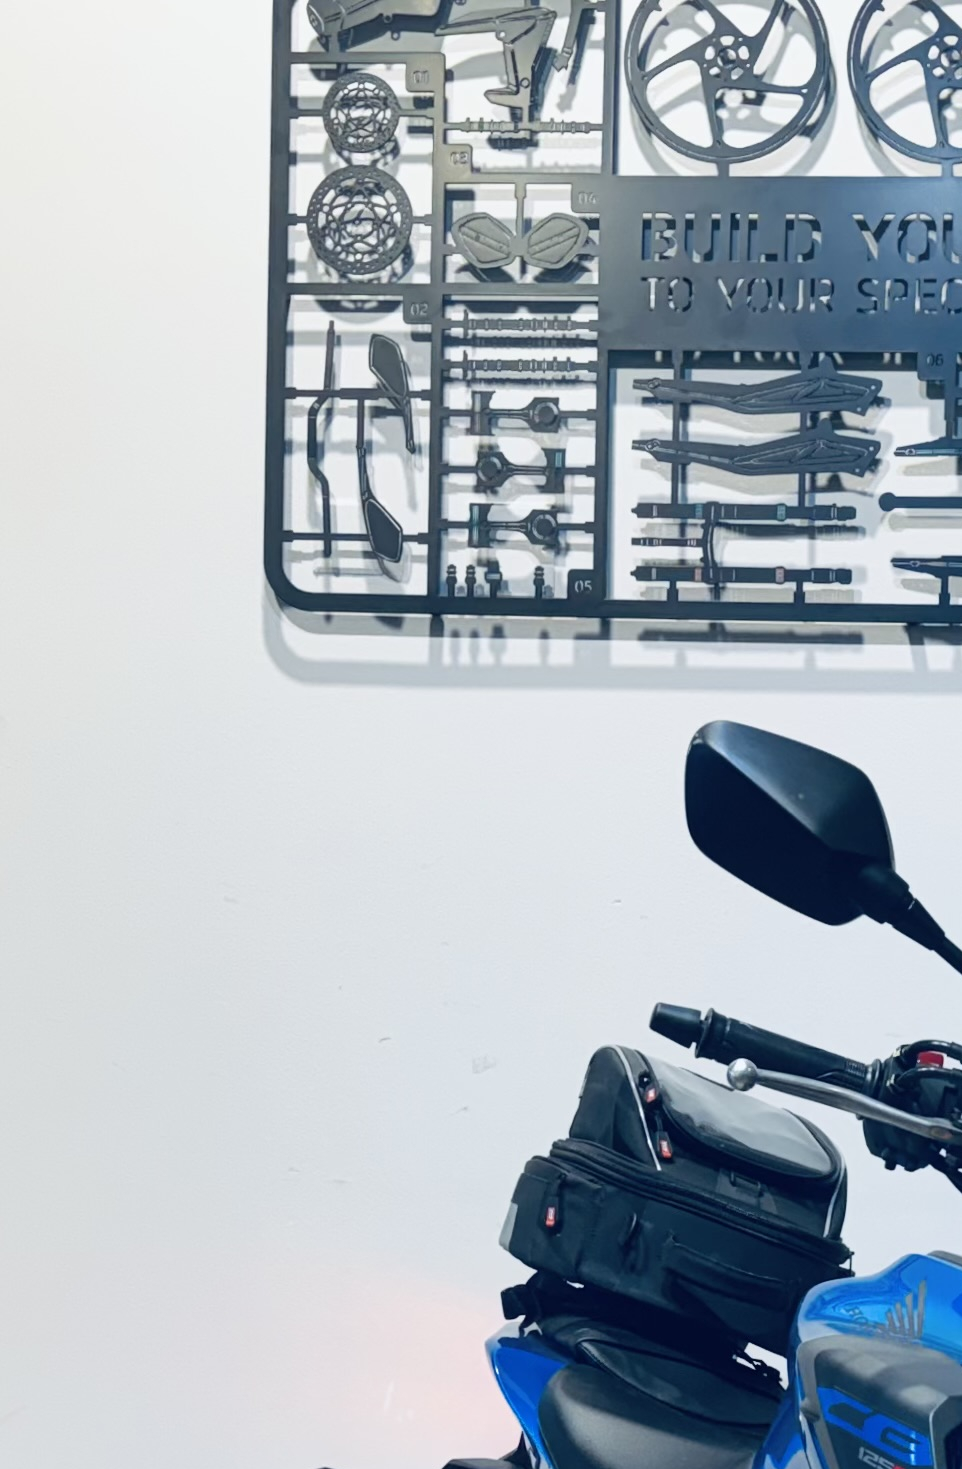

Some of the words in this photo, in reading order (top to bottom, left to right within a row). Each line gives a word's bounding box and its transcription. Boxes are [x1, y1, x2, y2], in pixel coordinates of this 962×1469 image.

[577, 191, 598, 206] 04
[641, 212, 823, 264] BUILD
[640, 276, 695, 313] TO
[716, 277, 836, 313] YOUR
[409, 302, 429, 316] 02
[925, 352, 944, 367] 06
[574, 579, 593, 593] 05
